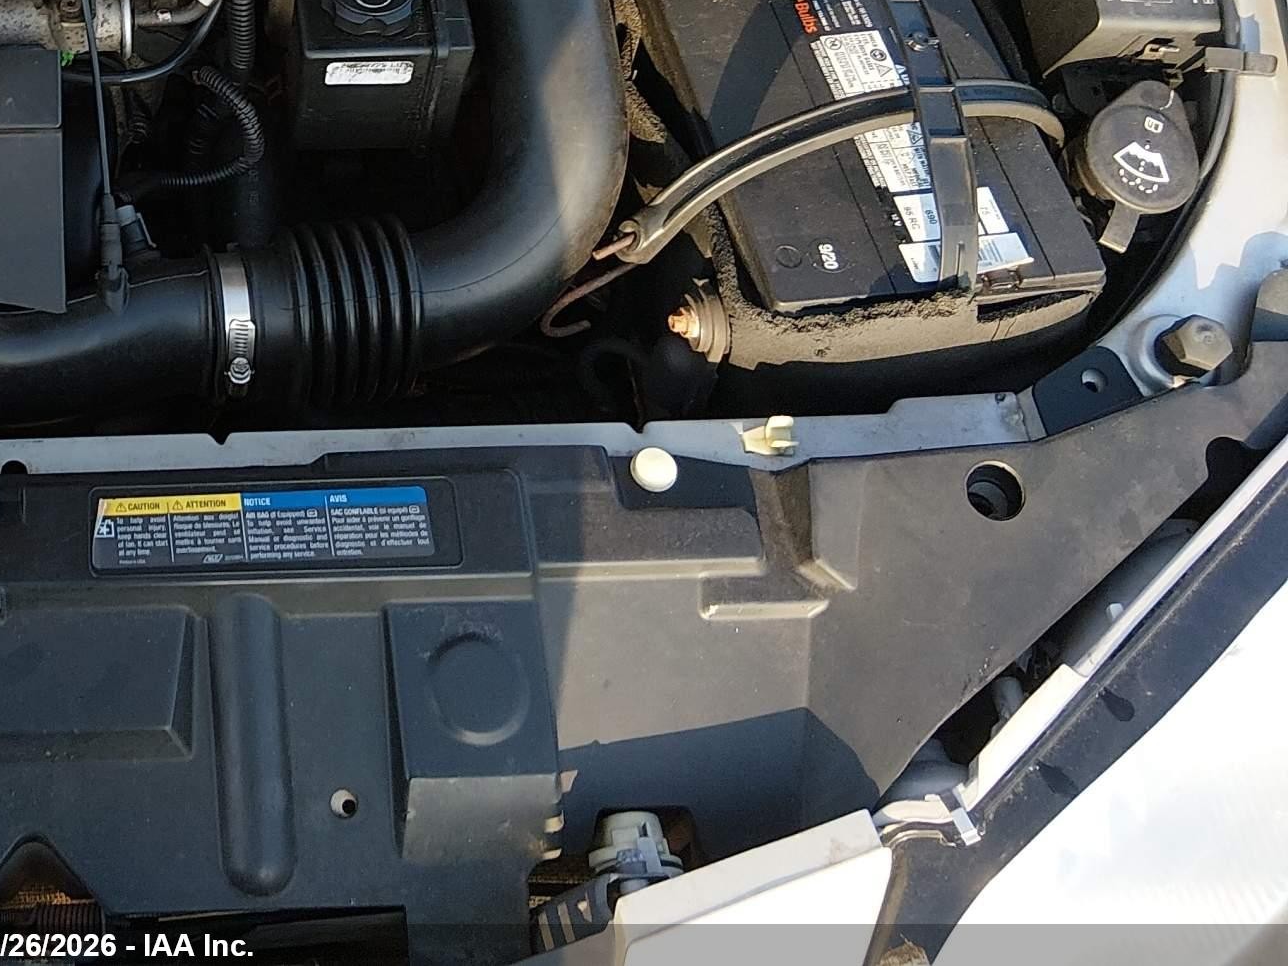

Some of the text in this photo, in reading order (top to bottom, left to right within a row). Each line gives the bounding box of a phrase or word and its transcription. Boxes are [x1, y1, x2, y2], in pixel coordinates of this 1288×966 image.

[818, 243, 839, 270] 9/20
[186, 500, 226, 508] ATTENTION
[244, 498, 270, 506] NOTICE
